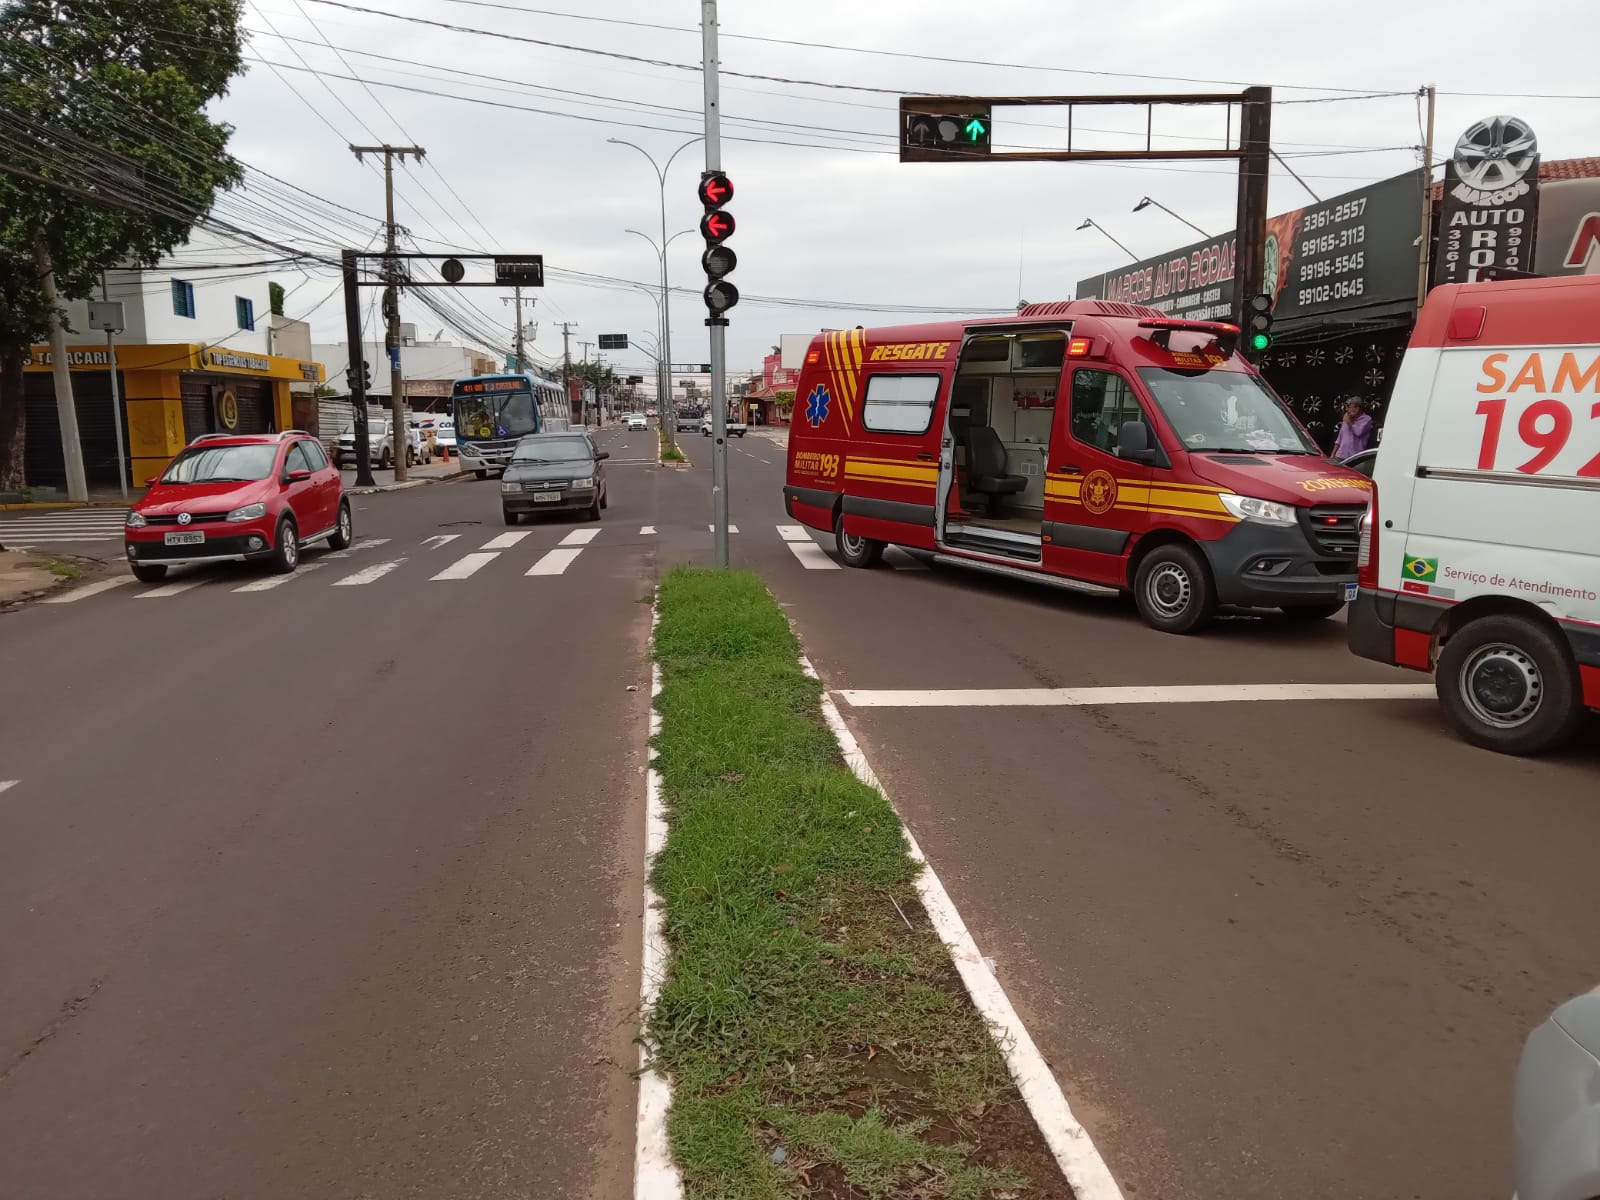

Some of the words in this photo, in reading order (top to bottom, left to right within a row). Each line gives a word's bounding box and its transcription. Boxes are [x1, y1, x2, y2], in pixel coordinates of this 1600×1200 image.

[1451, 179, 1530, 206] MARCOS
[1303, 197, 1368, 232] 3361-2557
[1450, 208, 1525, 226] AUTO
[1302, 225, 1366, 257] 99165-3113
[1107, 266, 1153, 304] MARCOS
[1154, 255, 1188, 298] AUTO
[1300, 251, 1365, 282] 99196-5545
[1299, 278, 1364, 306] 99102-0645
[870, 342, 952, 361] RESGATE
[795, 460, 819, 471] MILITAR
[820, 453, 840, 478] 193
[1444, 566, 1487, 585] Serviço
[1490, 573, 1505, 587] de
[1508, 577, 1596, 601] Atendimento
